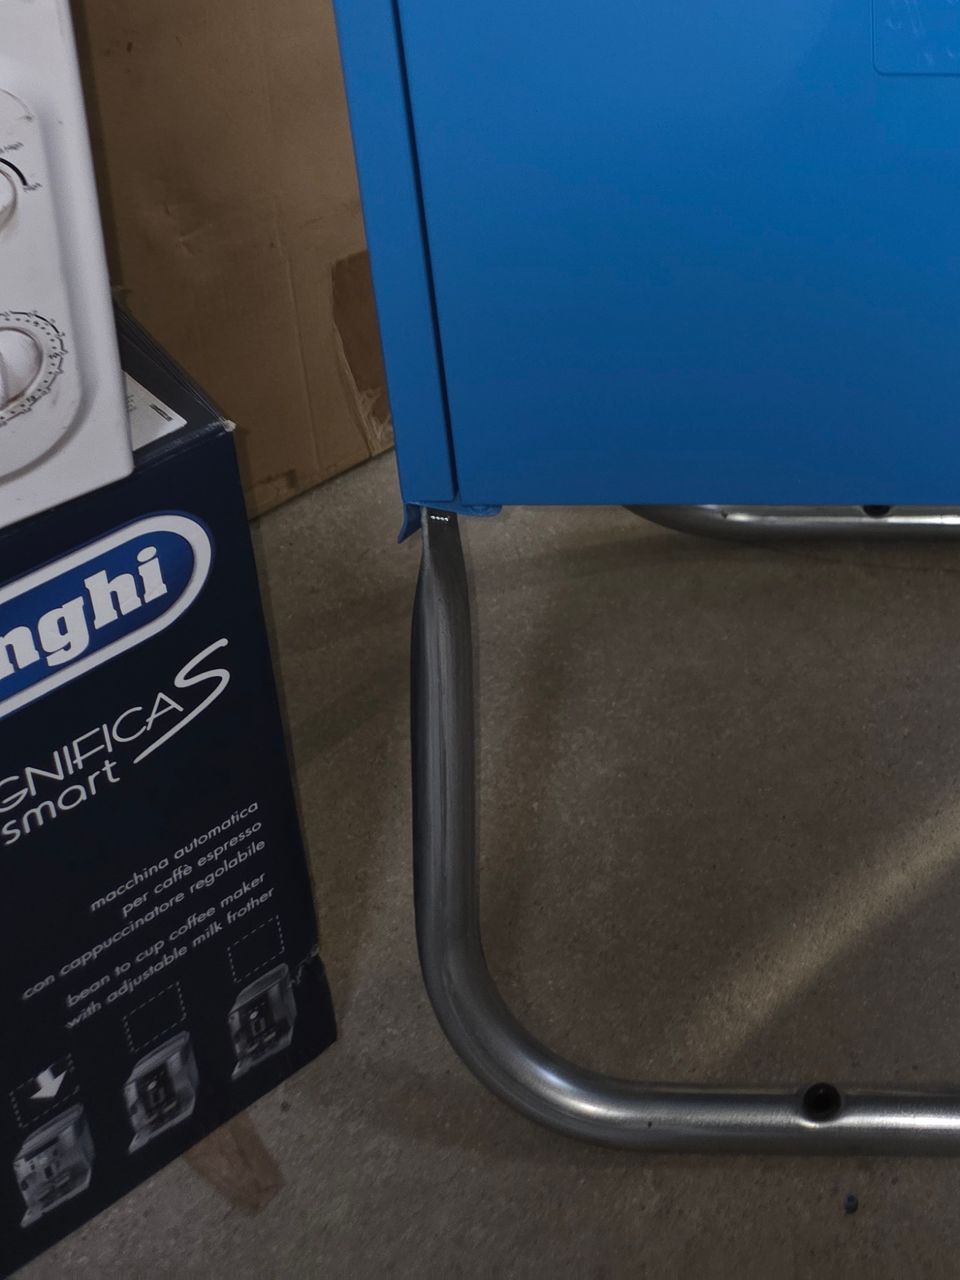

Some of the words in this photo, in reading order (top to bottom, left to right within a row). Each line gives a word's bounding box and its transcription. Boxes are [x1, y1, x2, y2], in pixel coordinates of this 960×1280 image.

[1, 759, 121, 846] smart
[90, 857, 170, 912] macchina
[174, 801, 259, 859] automatica
[22, 974, 56, 1001] con
[59, 891, 185, 977] cappuccinatore
[189, 840, 265, 894] regolabile
[122, 891, 149, 918] per
[153, 863, 193, 895] caffè
[197, 821, 262, 867] espresso
[65, 1000, 102, 1029] with
[105, 945, 188, 1004] adjustable
[192, 921, 223, 948] milk
[226, 887, 275, 925] frother
[66, 974, 110, 1008] bean
[114, 961, 131, 976] to
[135, 939, 165, 963] cup
[169, 906, 216, 941] coffee
[220, 872, 266, 908] maker
